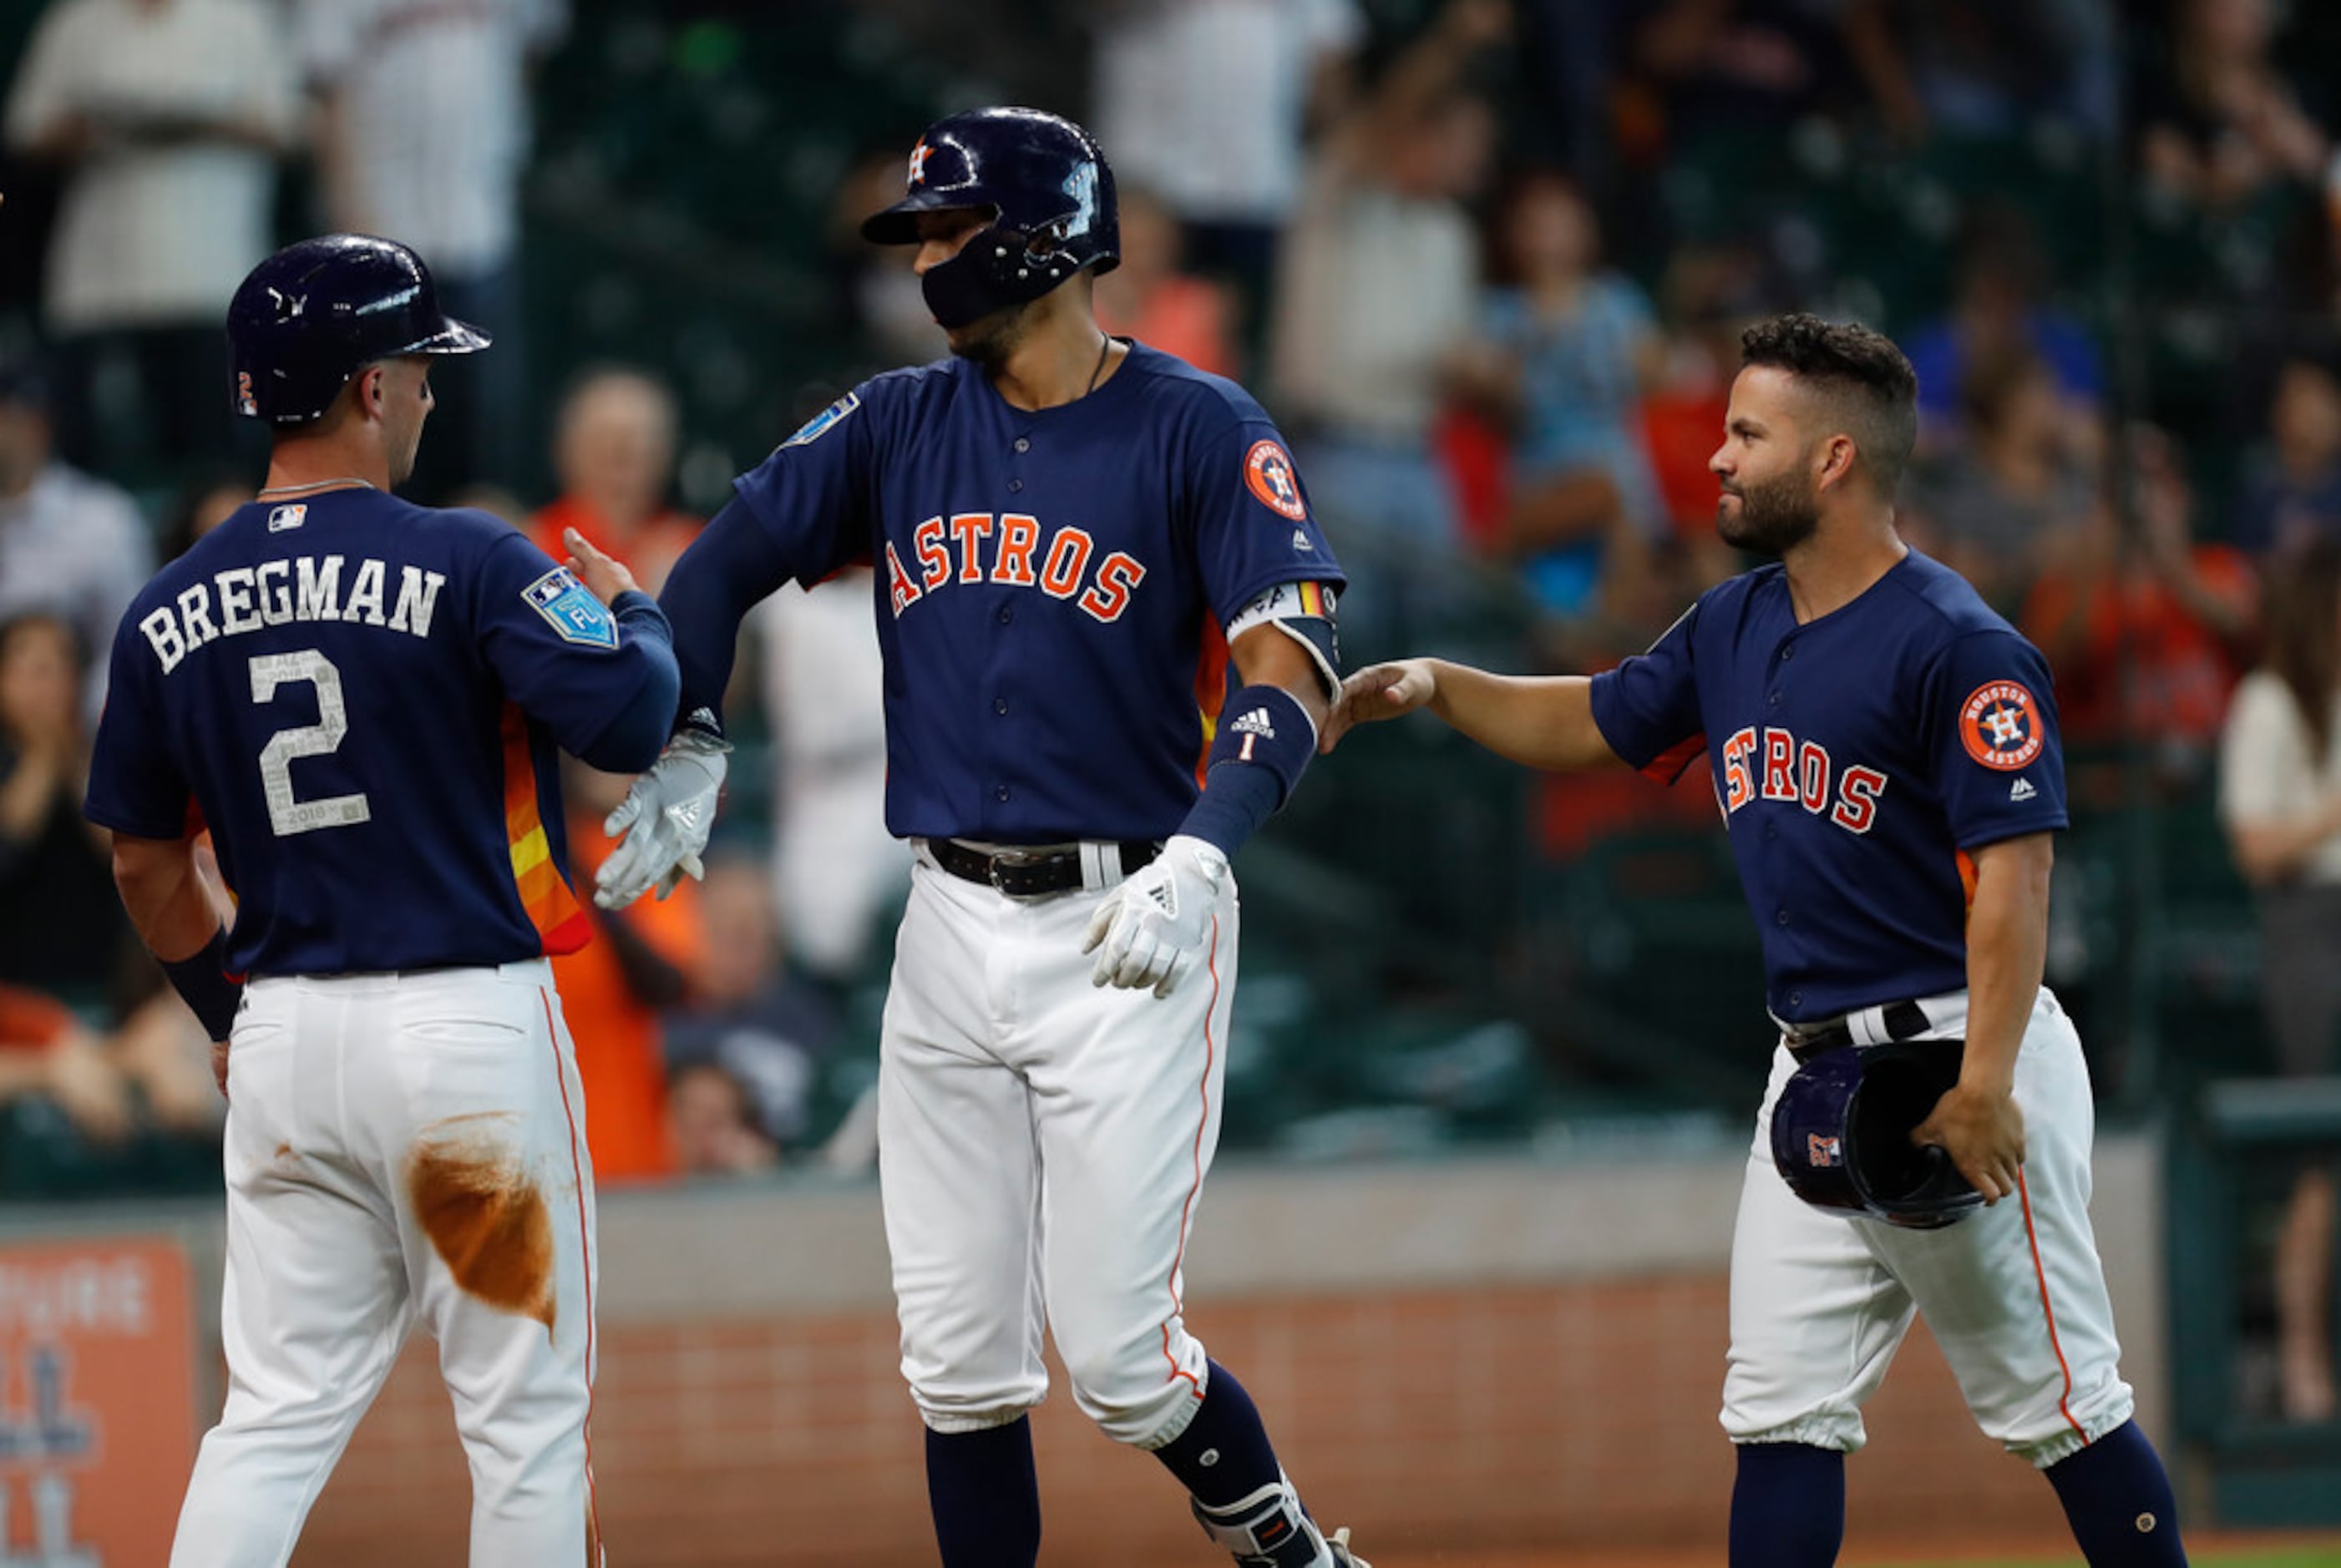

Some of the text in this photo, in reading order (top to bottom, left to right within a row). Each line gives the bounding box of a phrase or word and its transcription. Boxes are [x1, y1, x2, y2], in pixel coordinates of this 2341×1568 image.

[884, 512, 1148, 624] ASTROS
[139, 554, 446, 675] BREGMAN
[1230, 721, 1277, 741] adidas
[1965, 685, 2029, 721] HOUSTON
[248, 648, 372, 837] 2
[1239, 732, 1257, 761] 1
[1983, 736, 2040, 765] ASTROS
[1712, 726, 1889, 835] STROS
